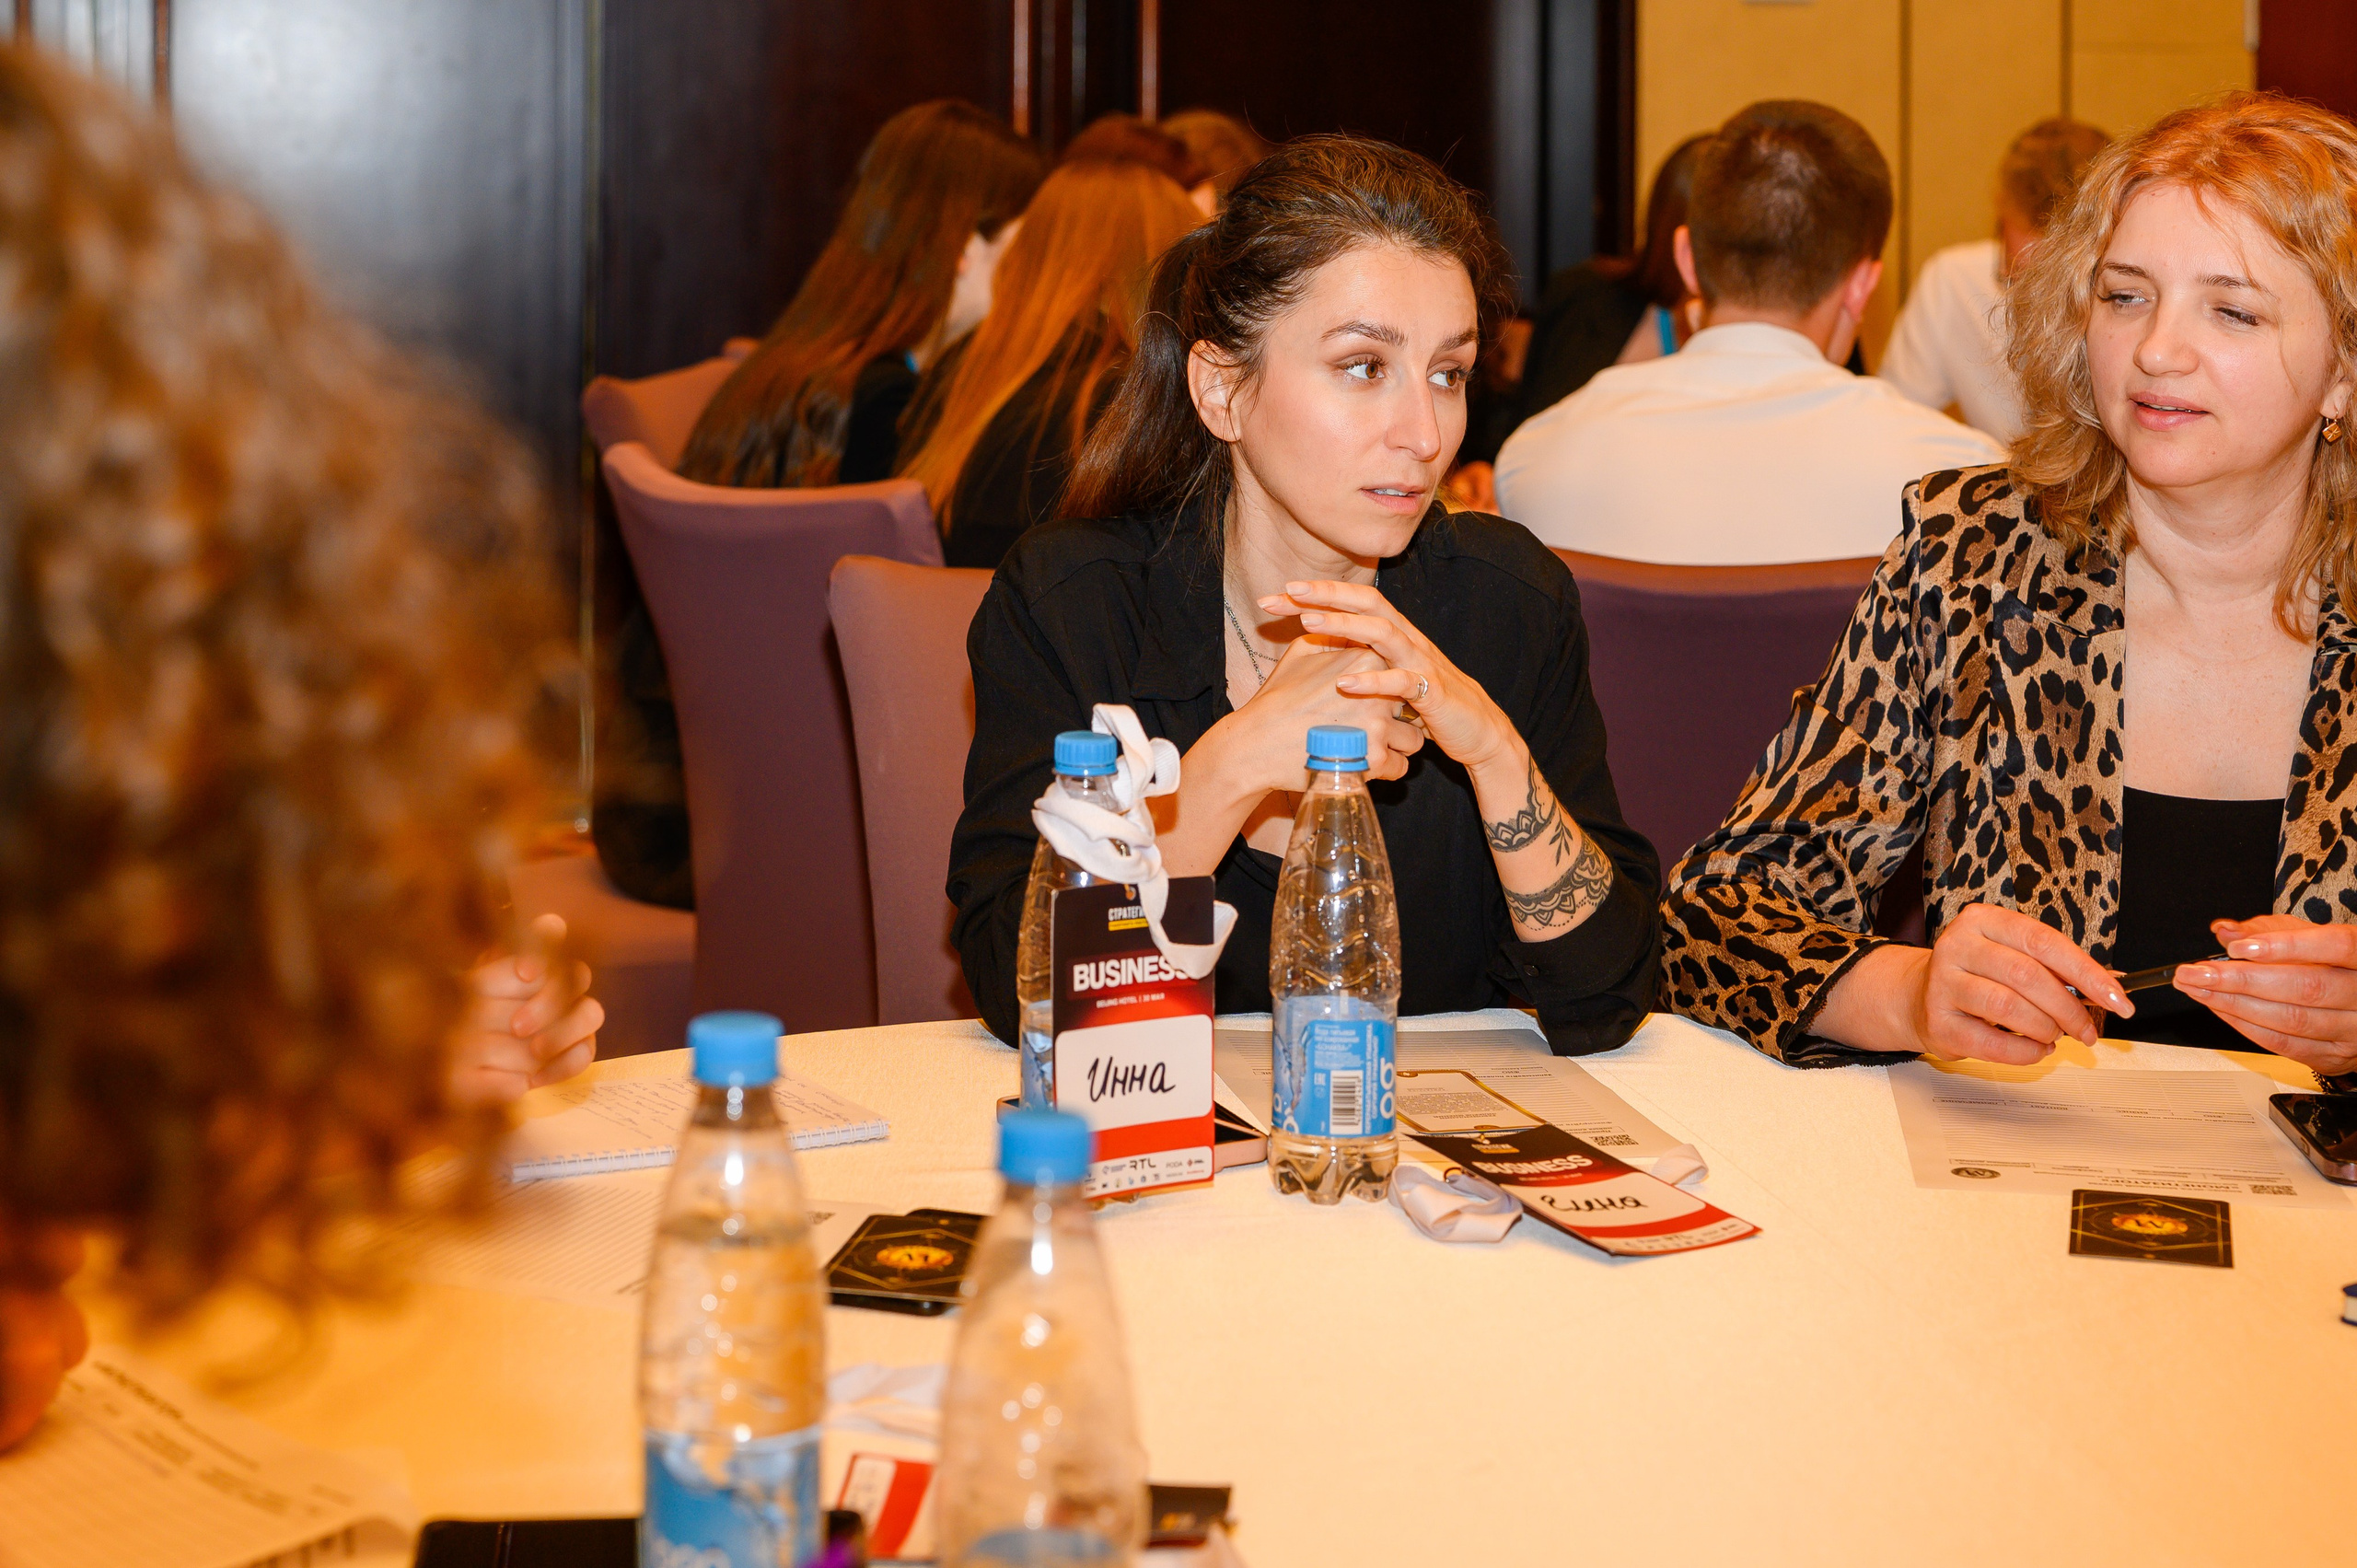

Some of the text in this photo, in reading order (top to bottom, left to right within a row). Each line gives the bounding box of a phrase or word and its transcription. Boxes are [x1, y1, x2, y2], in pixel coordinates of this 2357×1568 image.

[1073, 955, 1189, 992] BUSINES
[1086, 1056, 1176, 1103] Инна
[1129, 1157, 1156, 1170] RTL
[1471, 1155, 1593, 1175] BUSINESS
